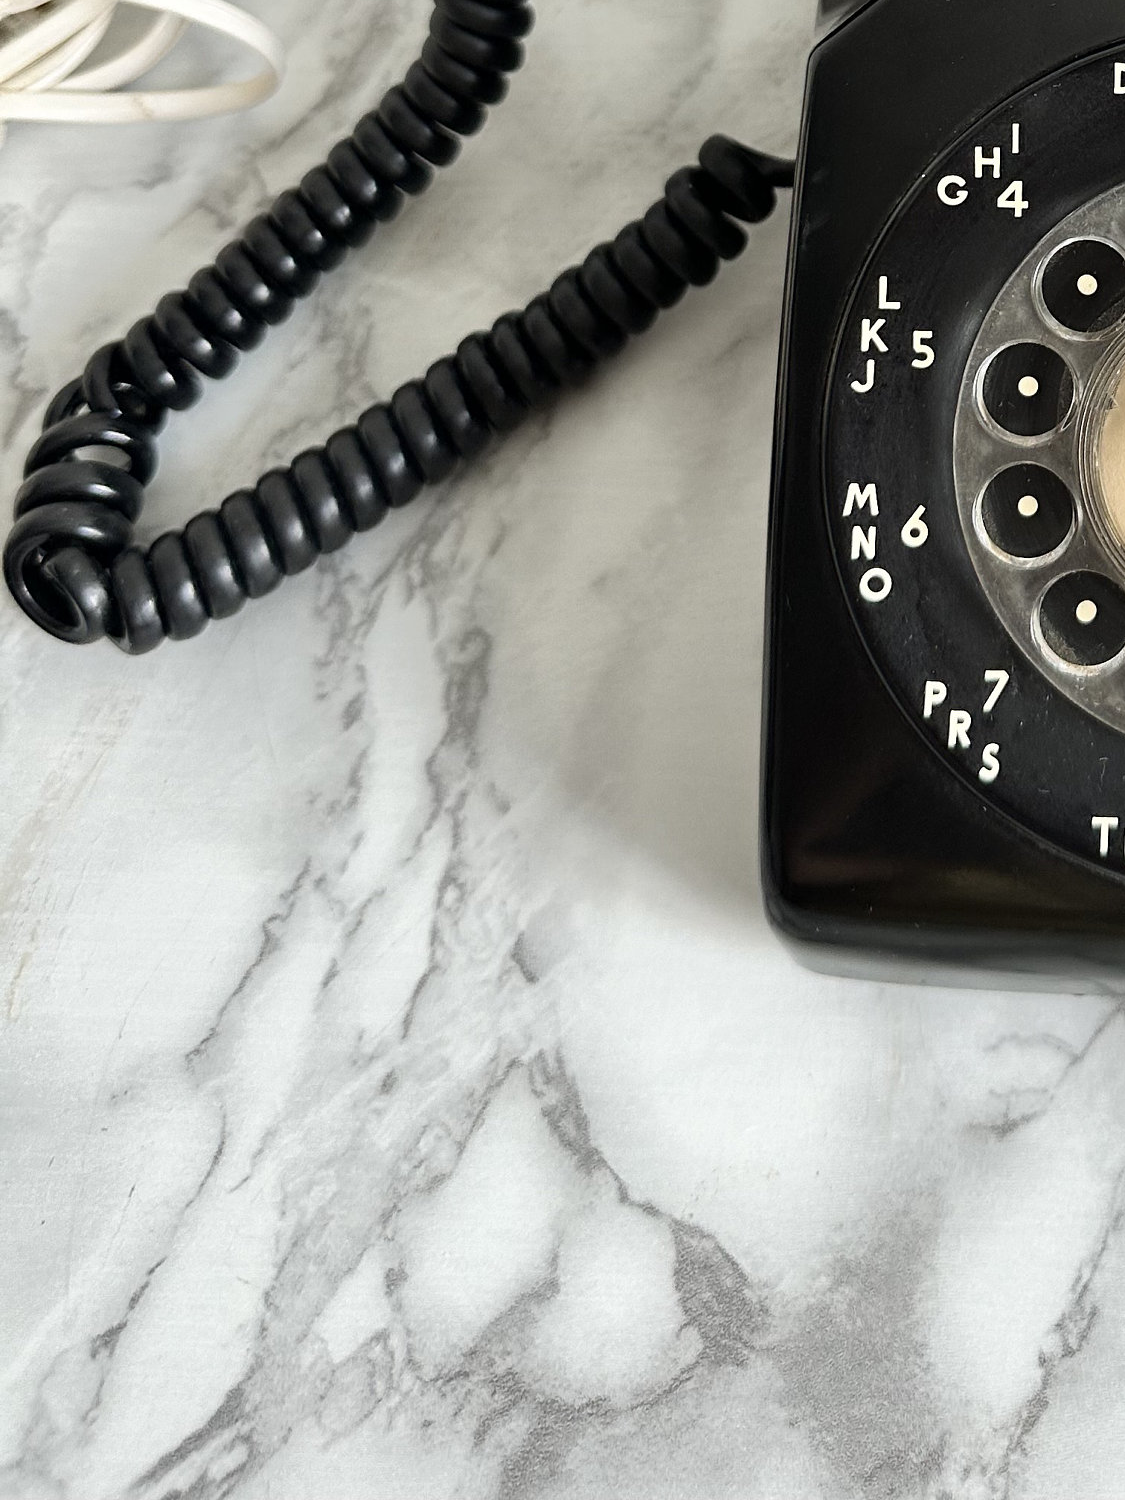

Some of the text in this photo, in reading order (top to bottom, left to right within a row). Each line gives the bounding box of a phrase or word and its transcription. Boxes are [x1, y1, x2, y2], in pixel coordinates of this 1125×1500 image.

[936, 122, 1023, 206] GHI
[996, 180, 1029, 218] 4
[911, 330, 935, 369] 5
[842, 482, 894, 603] MNO
[900, 504, 930, 548] 6
[982, 669, 1010, 713] 7
[923, 680, 1000, 783] PRS
